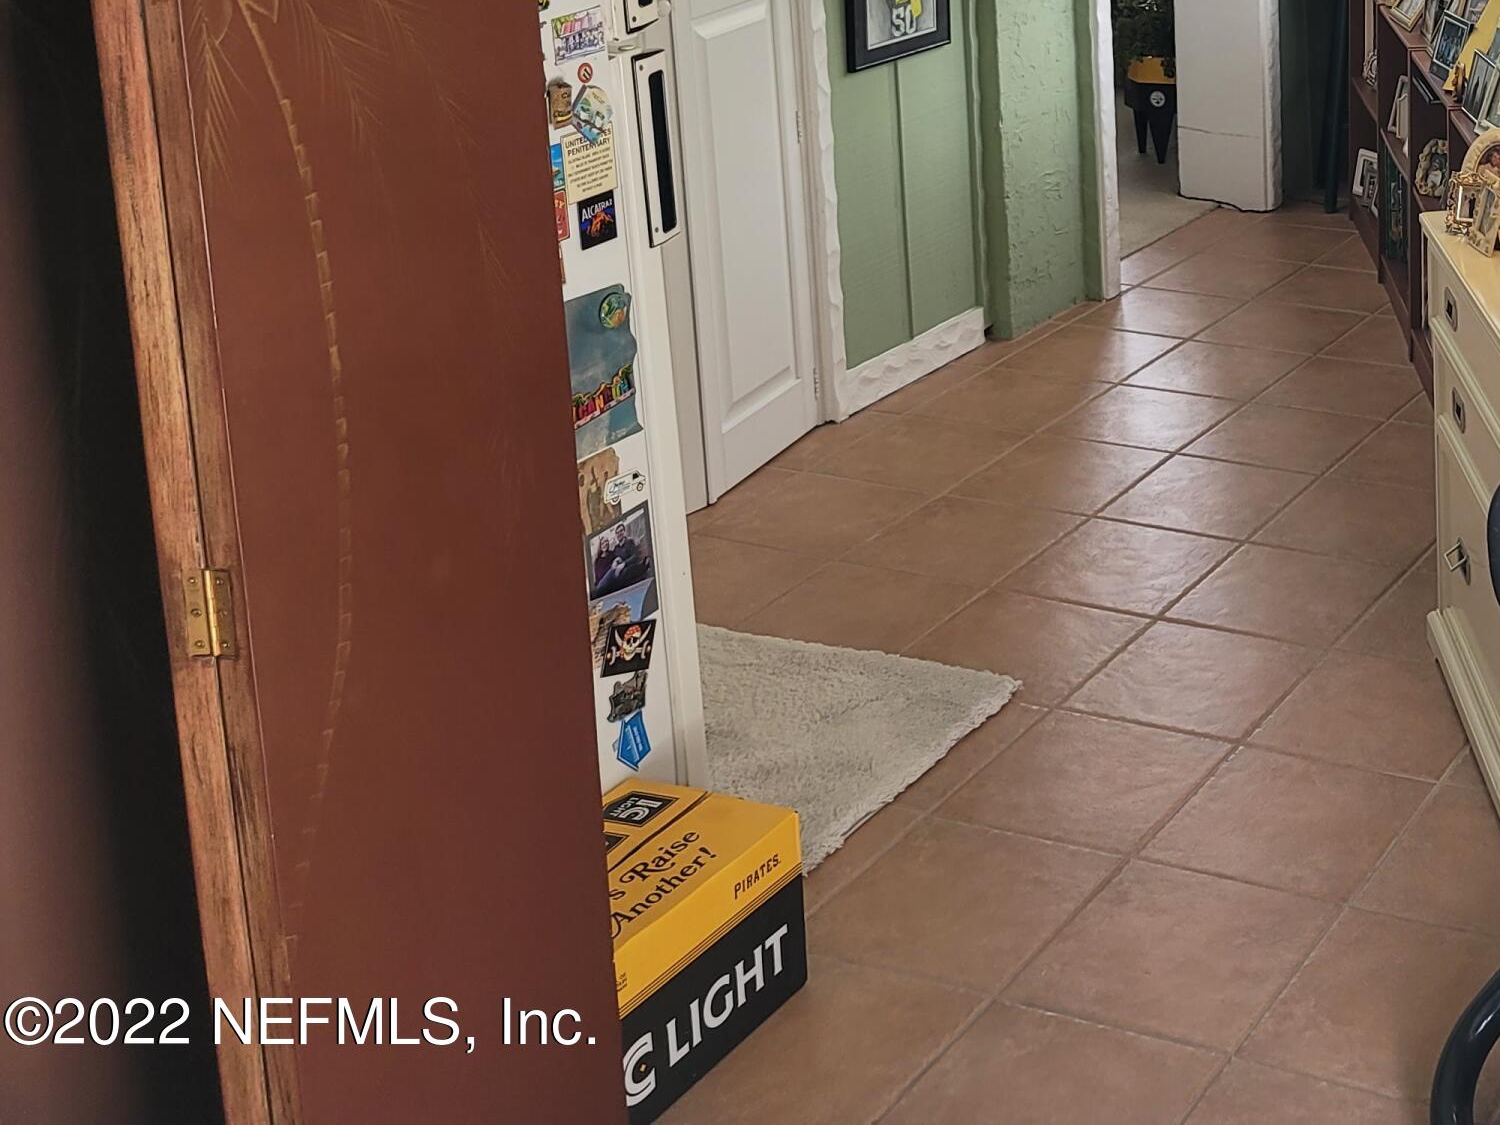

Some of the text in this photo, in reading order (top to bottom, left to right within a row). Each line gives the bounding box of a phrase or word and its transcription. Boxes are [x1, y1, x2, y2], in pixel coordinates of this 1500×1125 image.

[891, 6, 918, 37] 50
[581, 197, 613, 223] ALCATRAZ
[619, 830, 701, 883] Raise
[733, 853, 781, 900] PIRATES
[610, 845, 717, 939] Another!
[665, 923, 788, 1069] LIGHT
